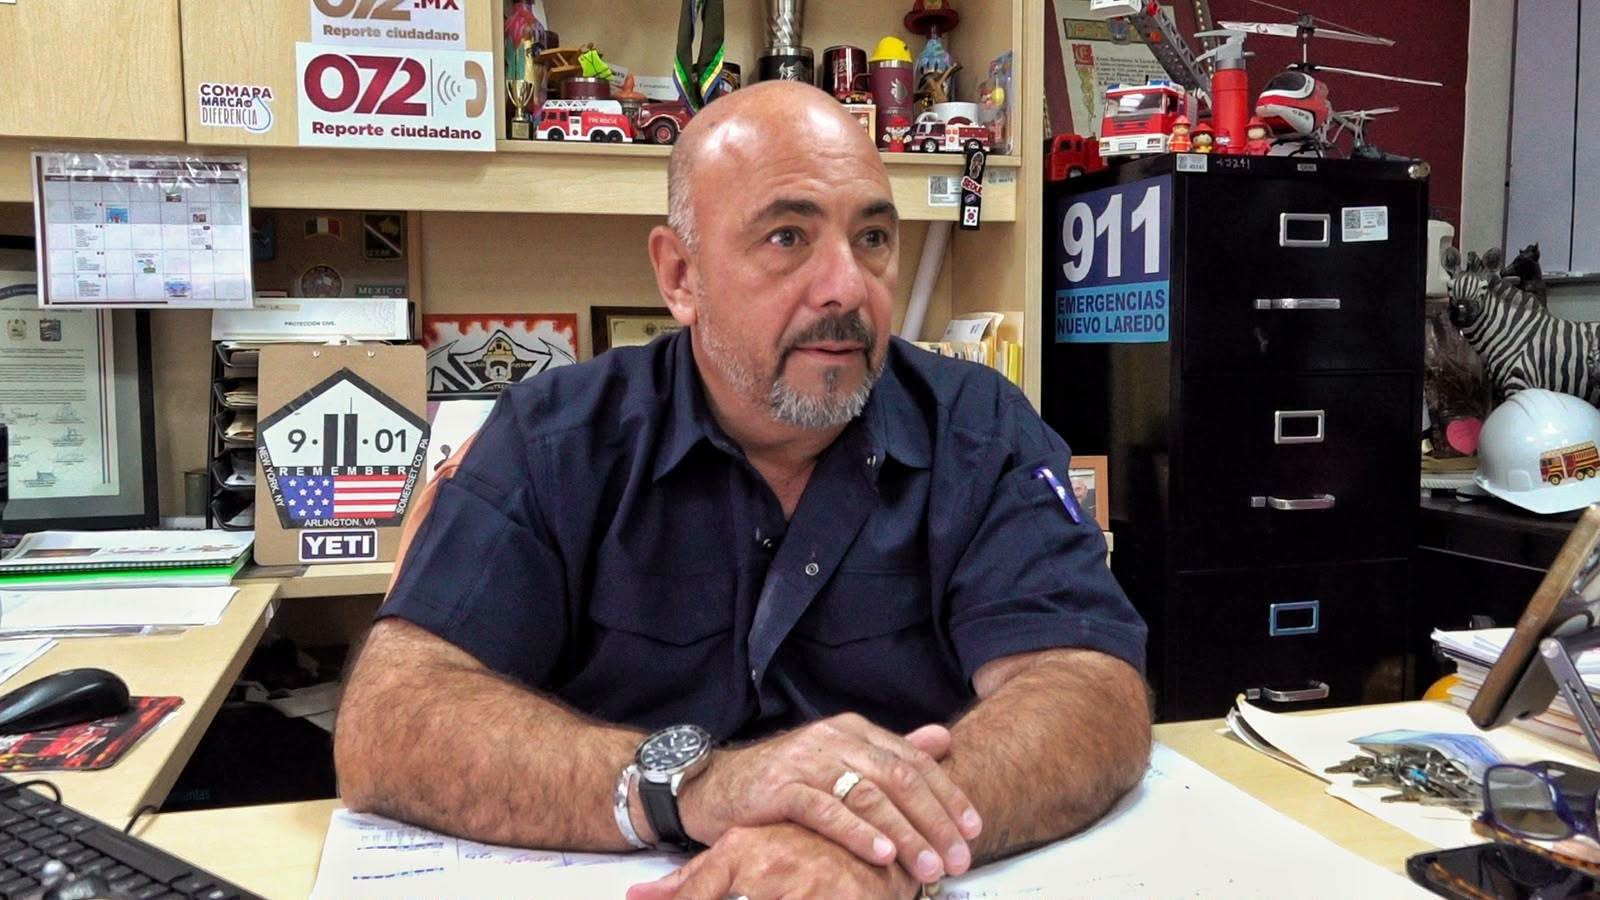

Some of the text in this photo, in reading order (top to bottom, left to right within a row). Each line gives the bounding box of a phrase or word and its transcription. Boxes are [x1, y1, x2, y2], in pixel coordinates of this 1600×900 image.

[323, 24, 460, 41] Reporte ciudadano
[200, 84, 272, 99] COMAPA
[304, 53, 427, 116] 072
[201, 96, 243, 108] MARCA
[202, 107, 257, 125] DIFERENCIA
[312, 121, 482, 140] Reporte ciudadano
[1062, 185, 1160, 283] 911
[1057, 289, 1165, 314] EMERGENCIAS
[1057, 313, 1165, 334] NUEVO LAREDO
[258, 446, 271, 466] NEW
[273, 494, 285, 506] NY
[279, 466, 407, 477] REMEMBER
[396, 467, 418, 514] SOMERSET
[419, 438, 429, 449] PA
[363, 518, 376, 526] VA
[304, 535, 371, 555] YETI
